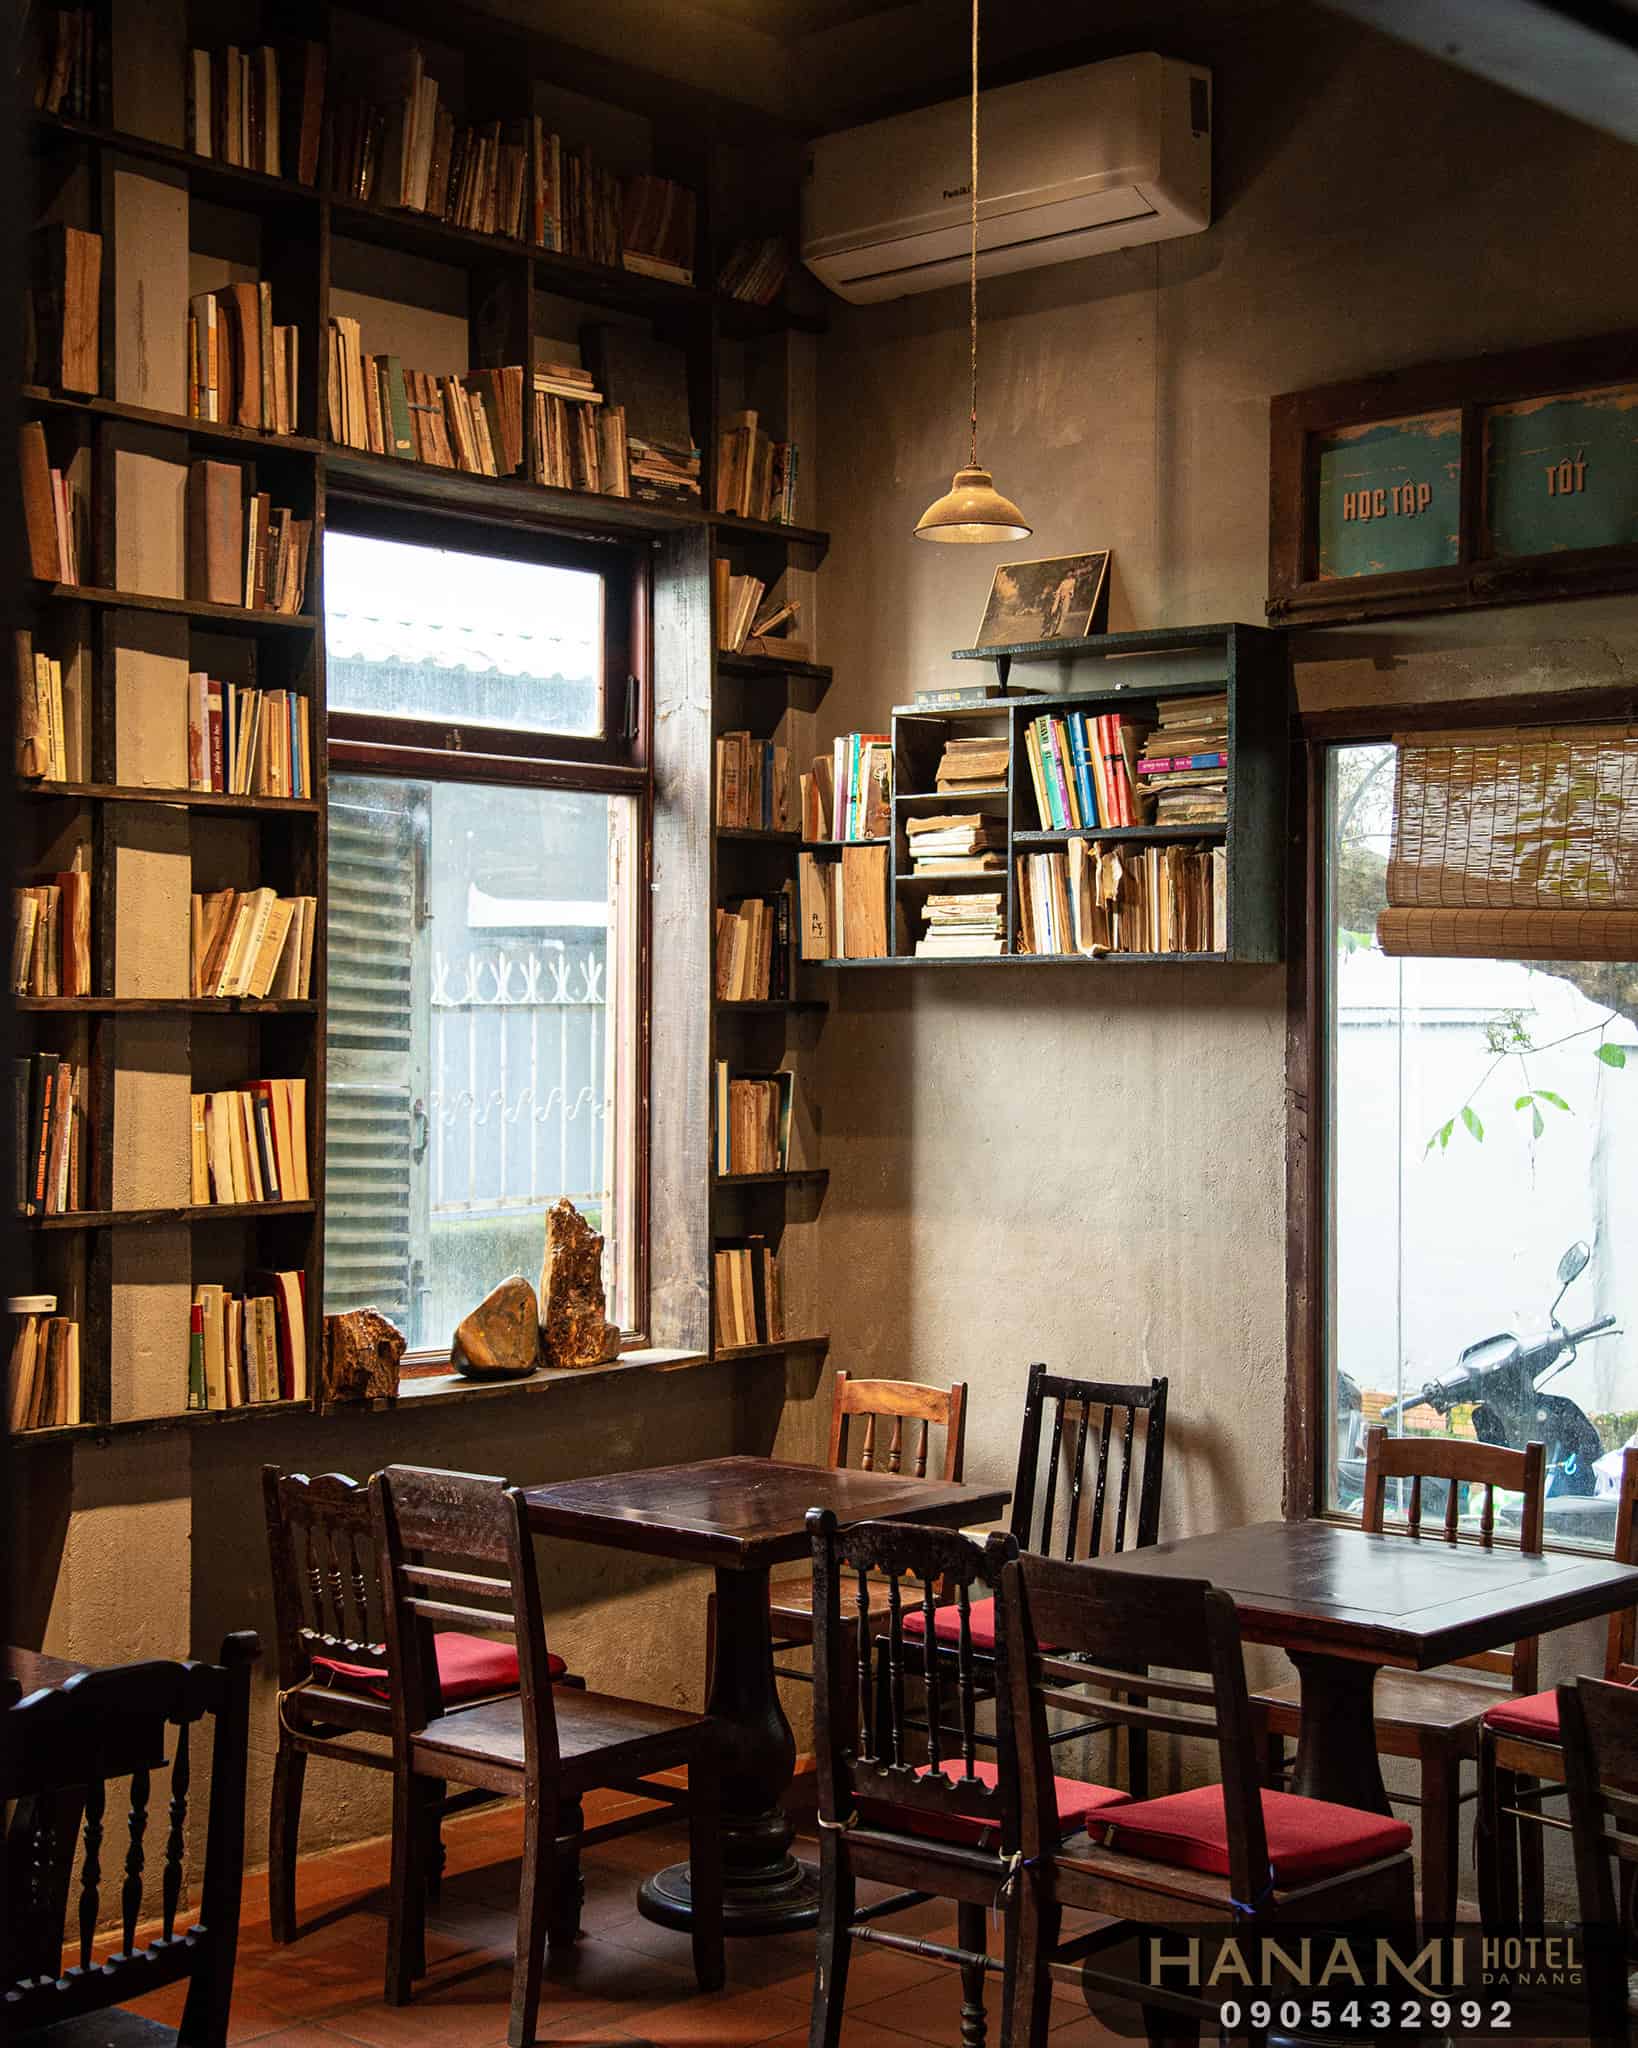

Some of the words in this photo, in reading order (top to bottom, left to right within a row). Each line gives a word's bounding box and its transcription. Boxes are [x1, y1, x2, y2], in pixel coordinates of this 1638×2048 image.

[1545, 450, 1589, 496] TỐT
[1343, 488, 1386, 525] HỌC
[1391, 479, 1432, 519] TẬP
